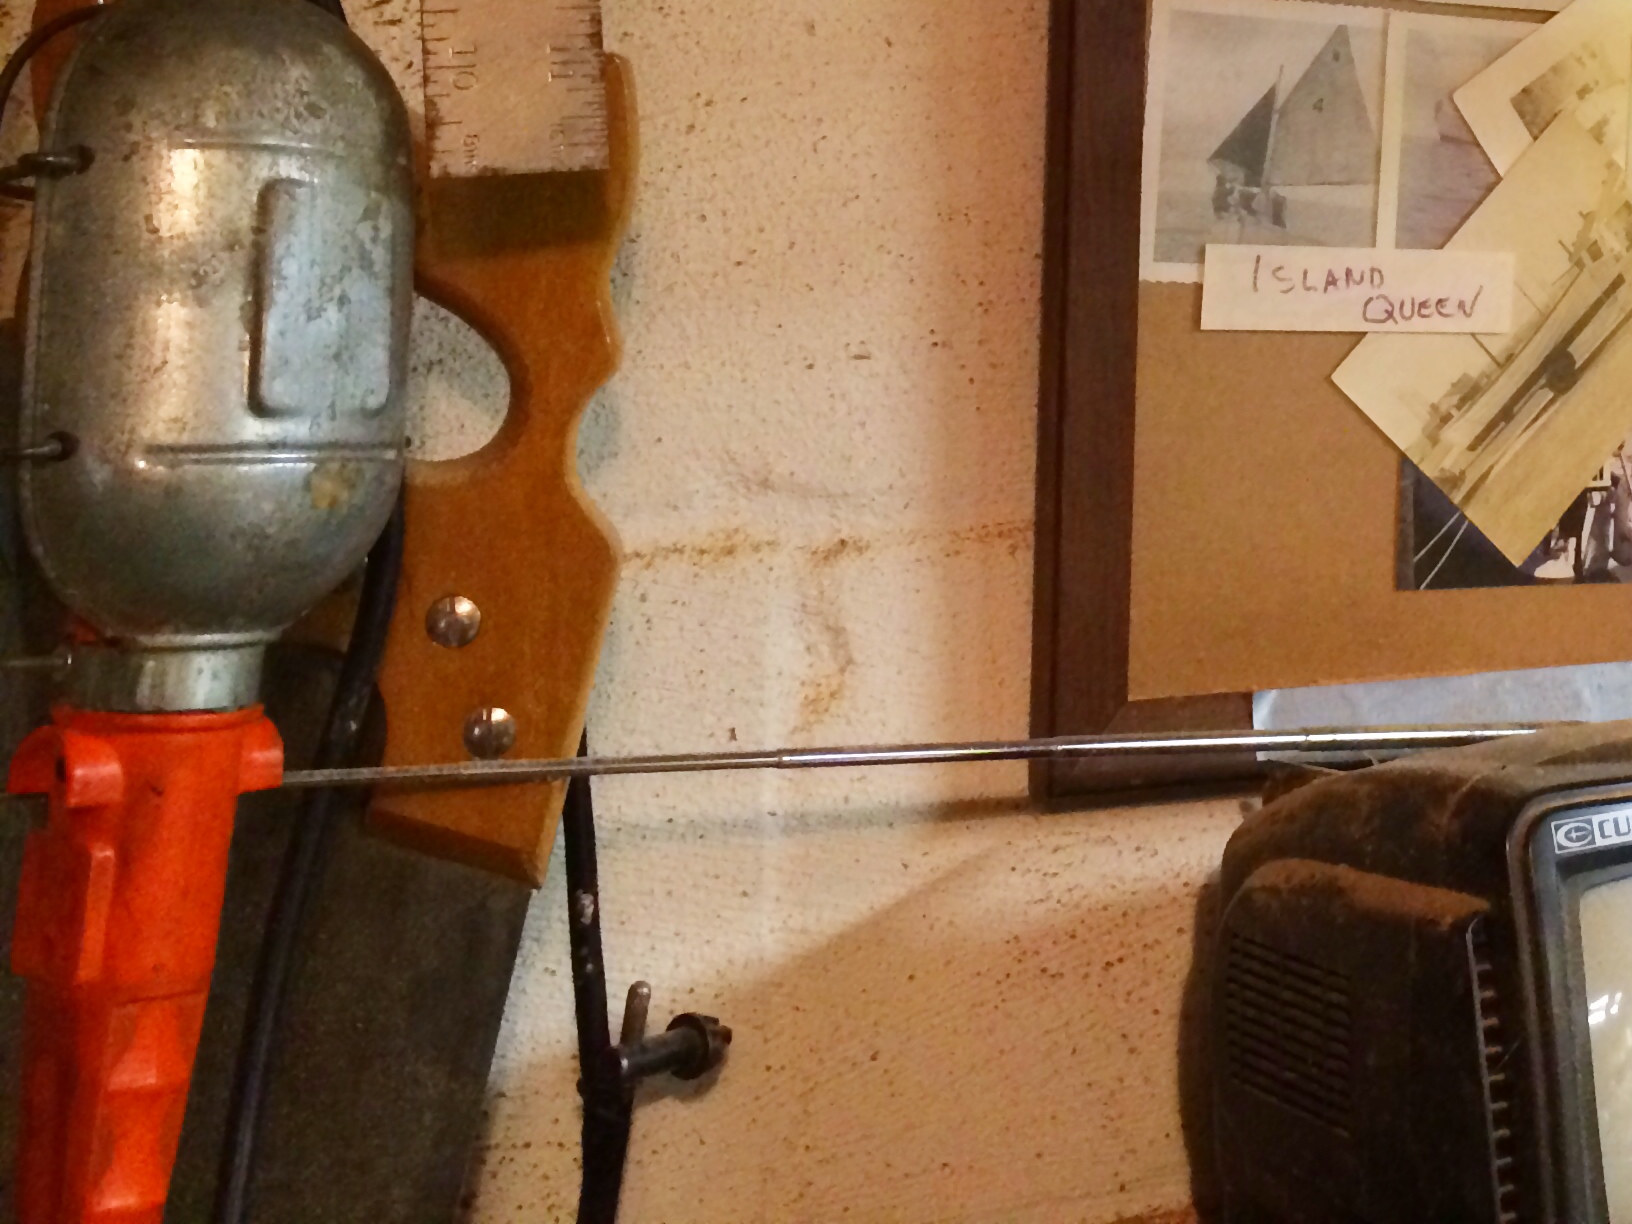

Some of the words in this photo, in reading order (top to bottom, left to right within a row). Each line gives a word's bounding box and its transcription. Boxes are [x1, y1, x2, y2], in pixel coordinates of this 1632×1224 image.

[449, 42, 478, 91] 10
[1251, 254, 1386, 294] ISLAND
[1361, 284, 1484, 325] QUEEN
